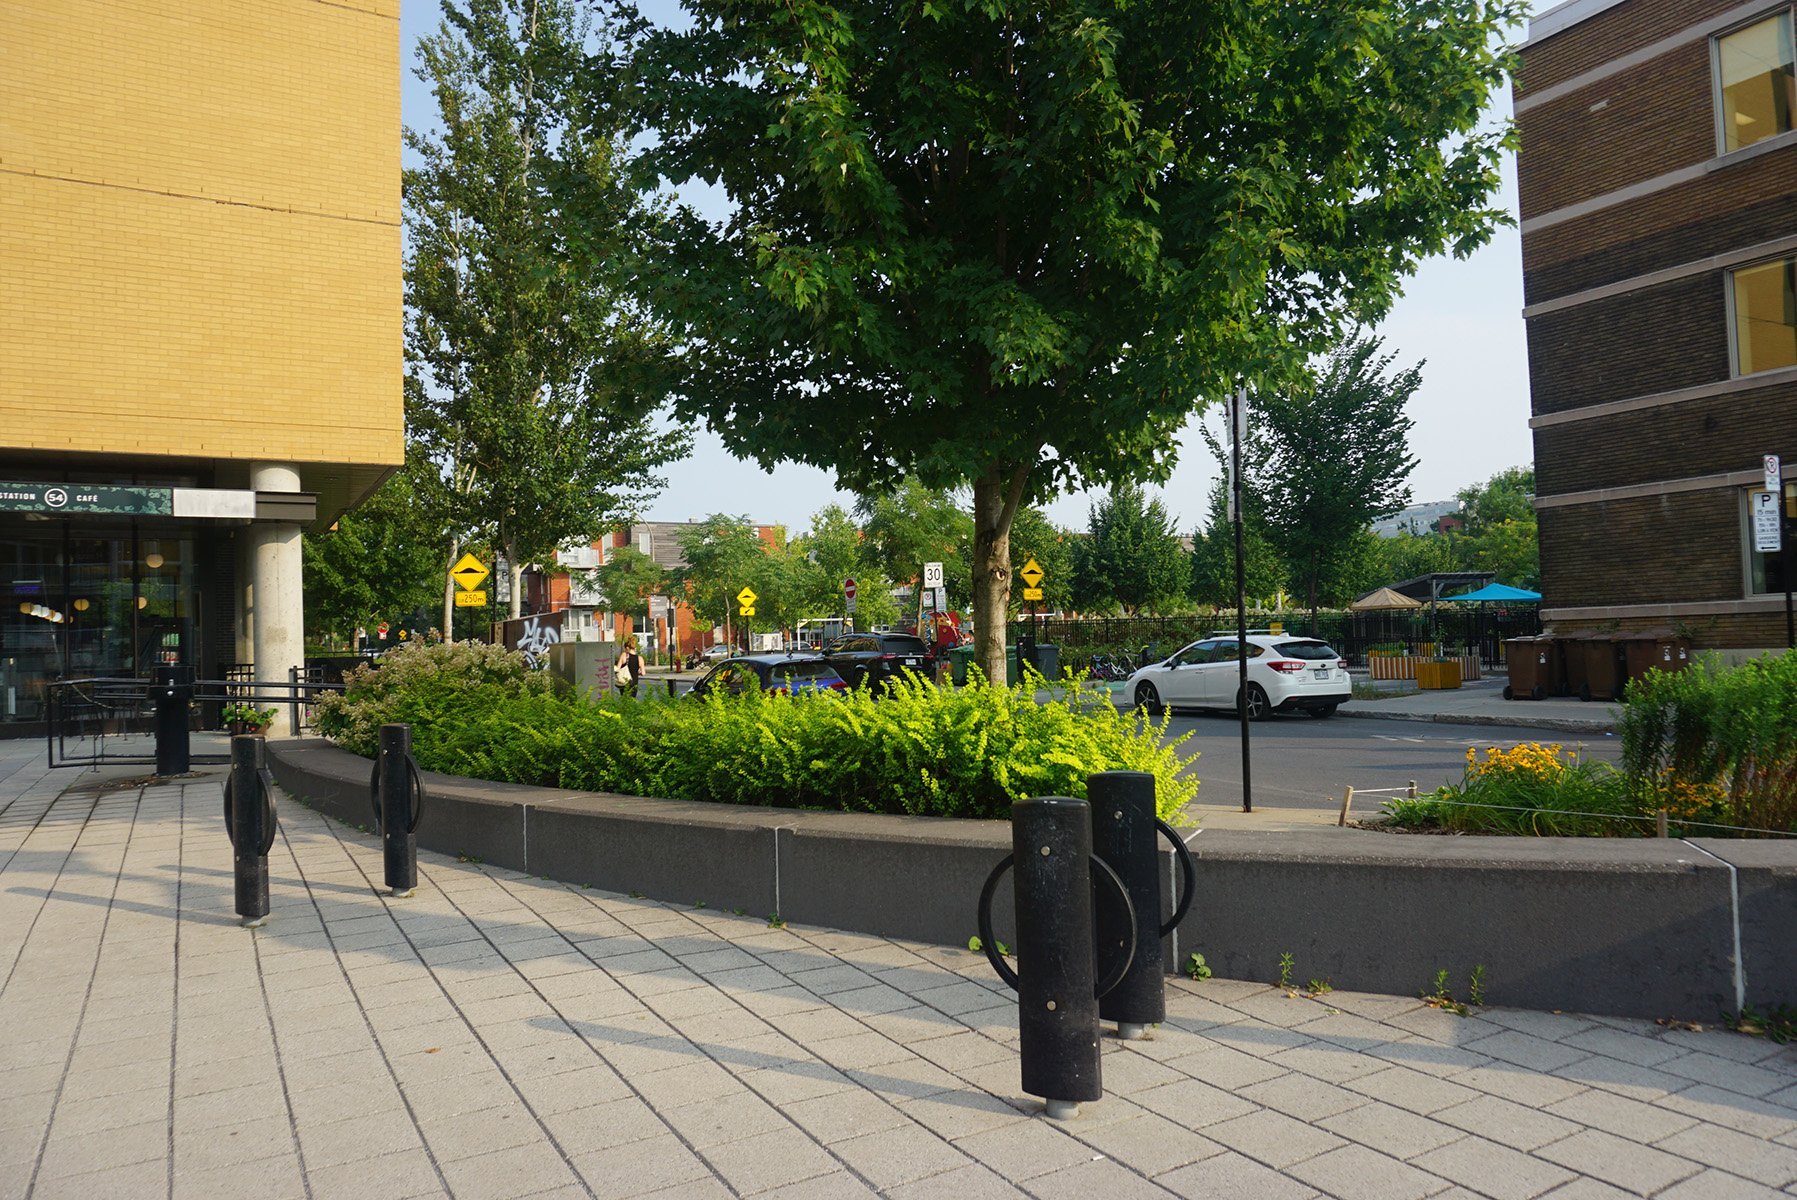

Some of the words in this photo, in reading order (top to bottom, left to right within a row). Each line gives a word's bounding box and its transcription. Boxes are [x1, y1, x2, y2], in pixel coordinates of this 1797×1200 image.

[48, 493, 64, 502] 54
[1762, 495, 1771, 507] P
[927, 568, 940, 581] 30
